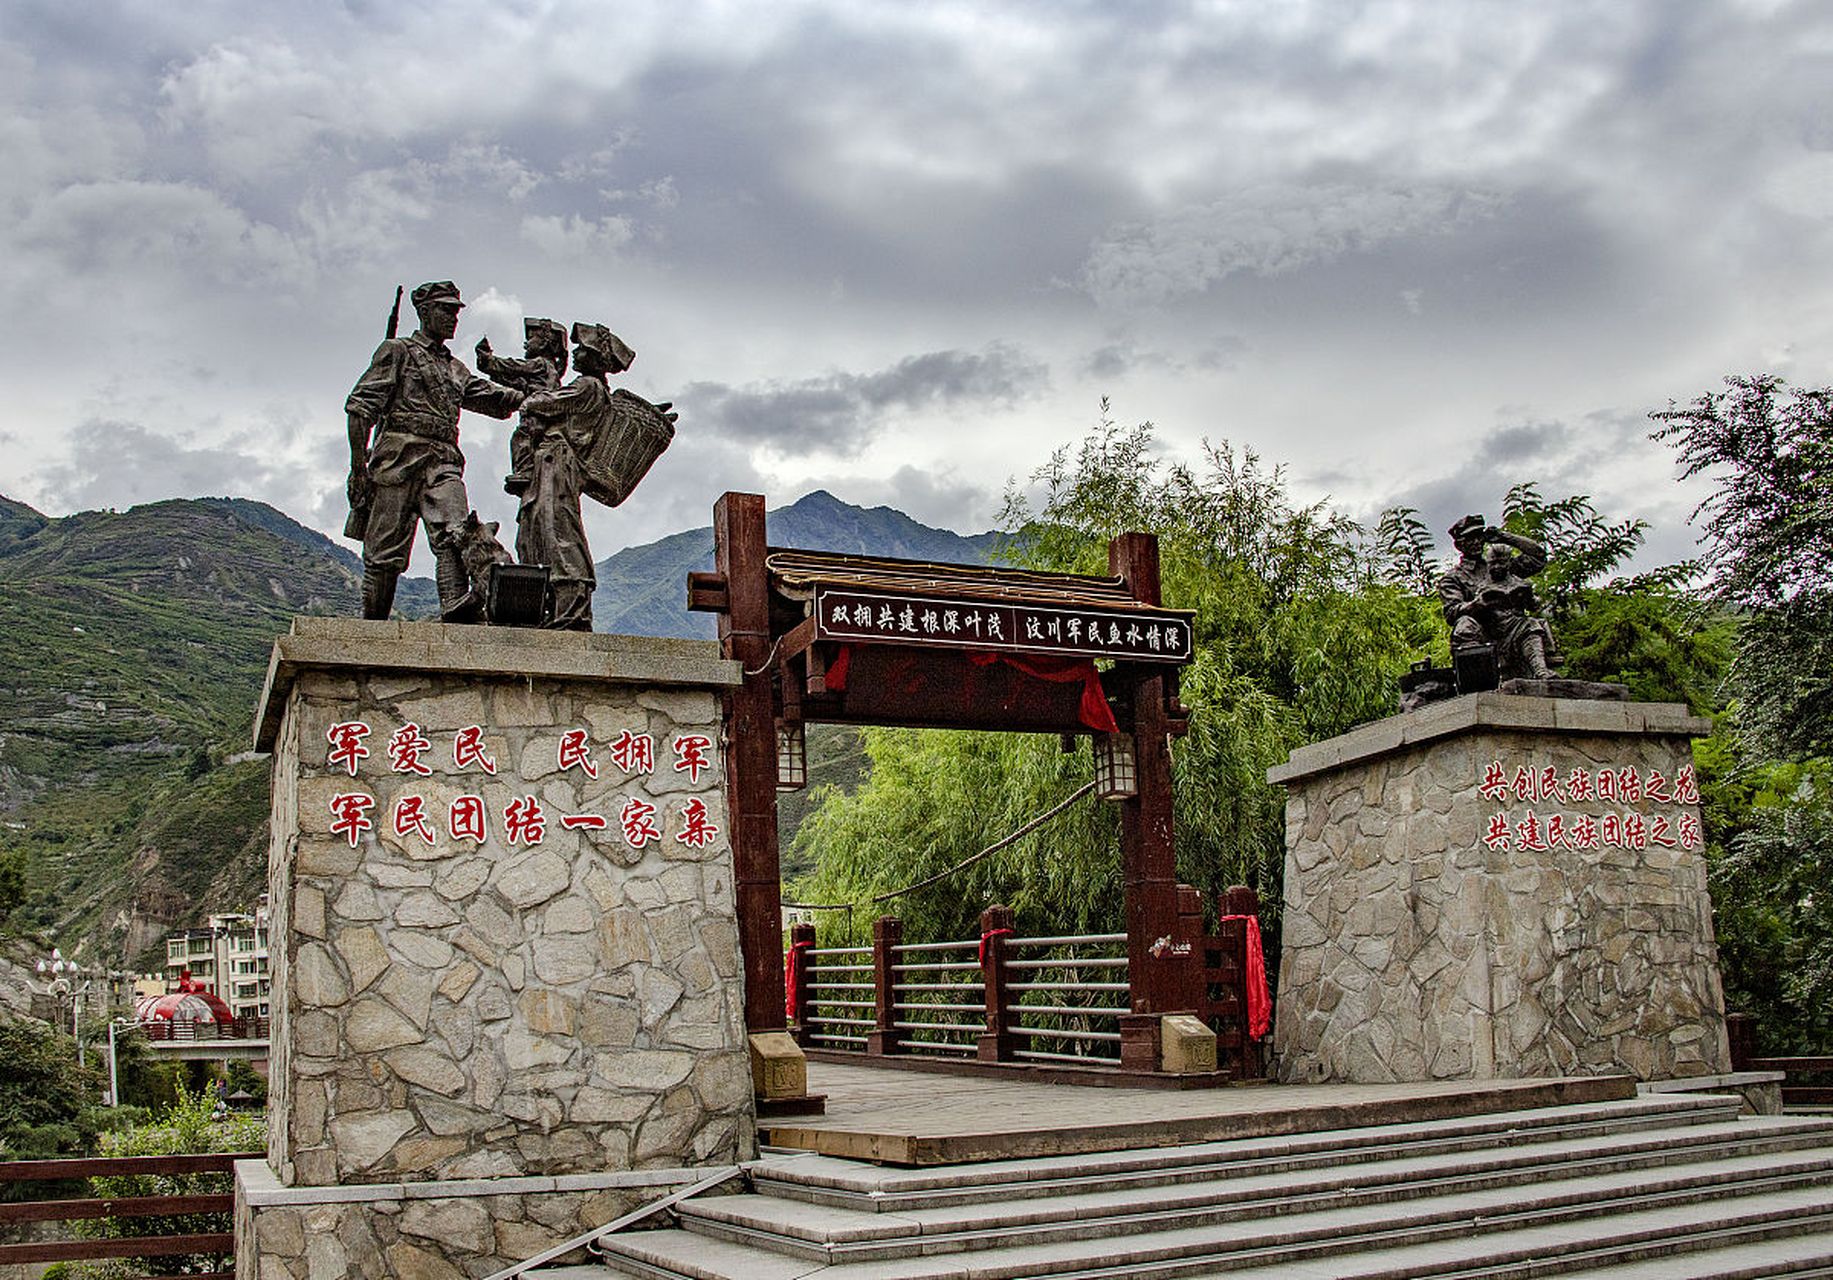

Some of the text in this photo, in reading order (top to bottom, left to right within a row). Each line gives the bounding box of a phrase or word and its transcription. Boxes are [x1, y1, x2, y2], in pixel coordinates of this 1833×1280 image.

[831, 602, 1004, 641] 双拥共建根深叶茂
[1025, 616, 1180, 651] 汶川军民鱼水情深
[326, 721, 712, 783] 军爱民 民拥军
[1479, 761, 1701, 804] 共创民族团结之花
[329, 794, 720, 849] 军民团结一家亲
[1483, 810, 1701, 851] 共建民族团结之家
